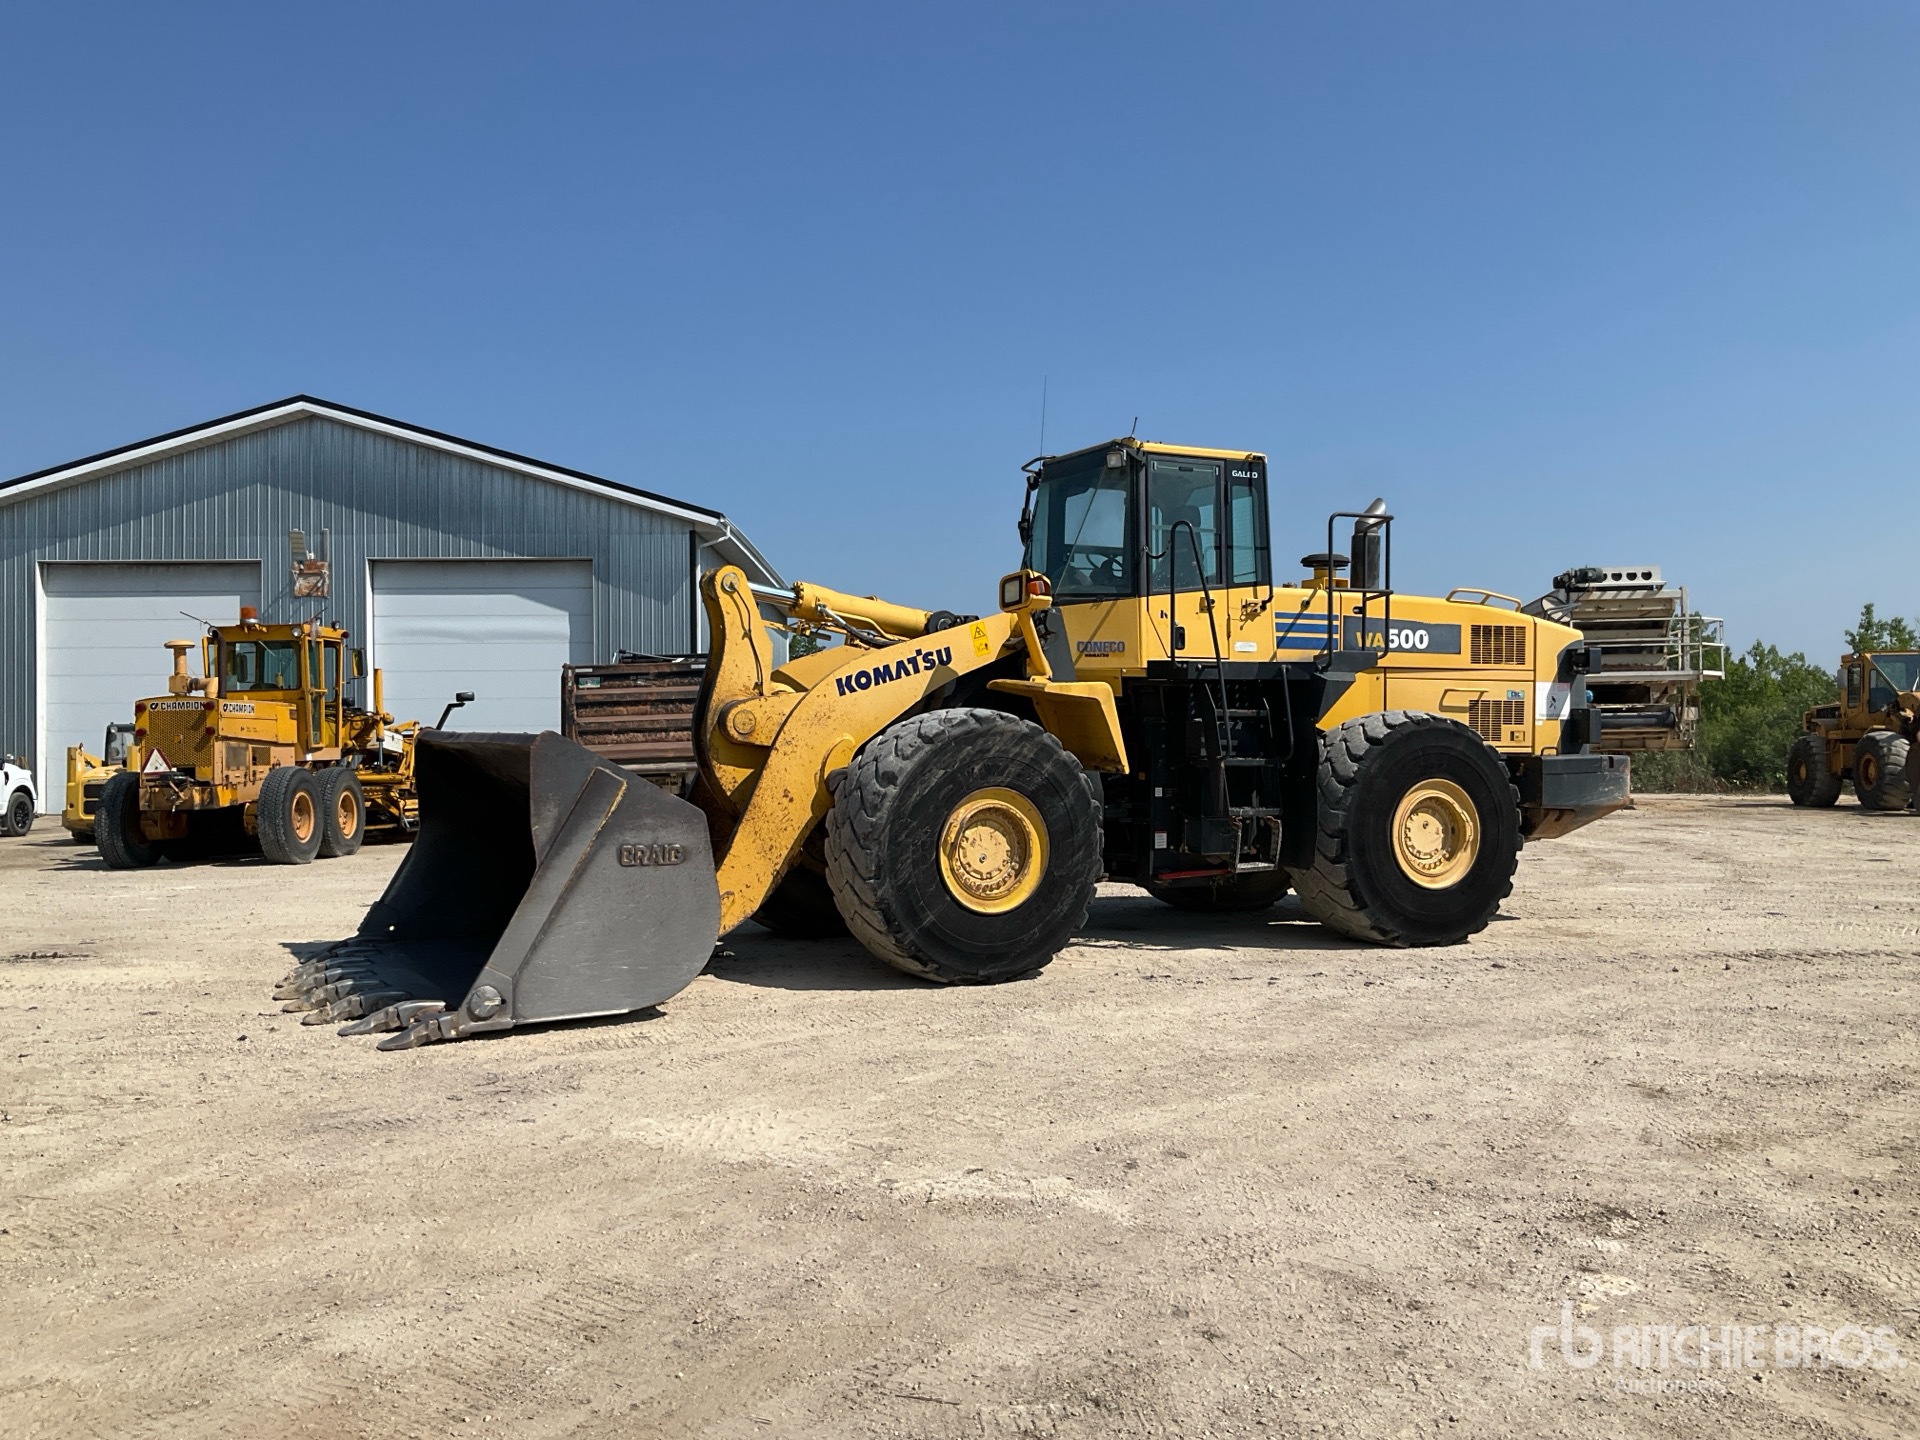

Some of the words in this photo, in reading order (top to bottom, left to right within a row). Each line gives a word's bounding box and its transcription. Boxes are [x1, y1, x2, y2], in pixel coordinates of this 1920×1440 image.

[1076, 641, 1126, 653] CONECO
[835, 646, 953, 697] KOMATSU
[160, 701, 206, 711] CHAMPION
